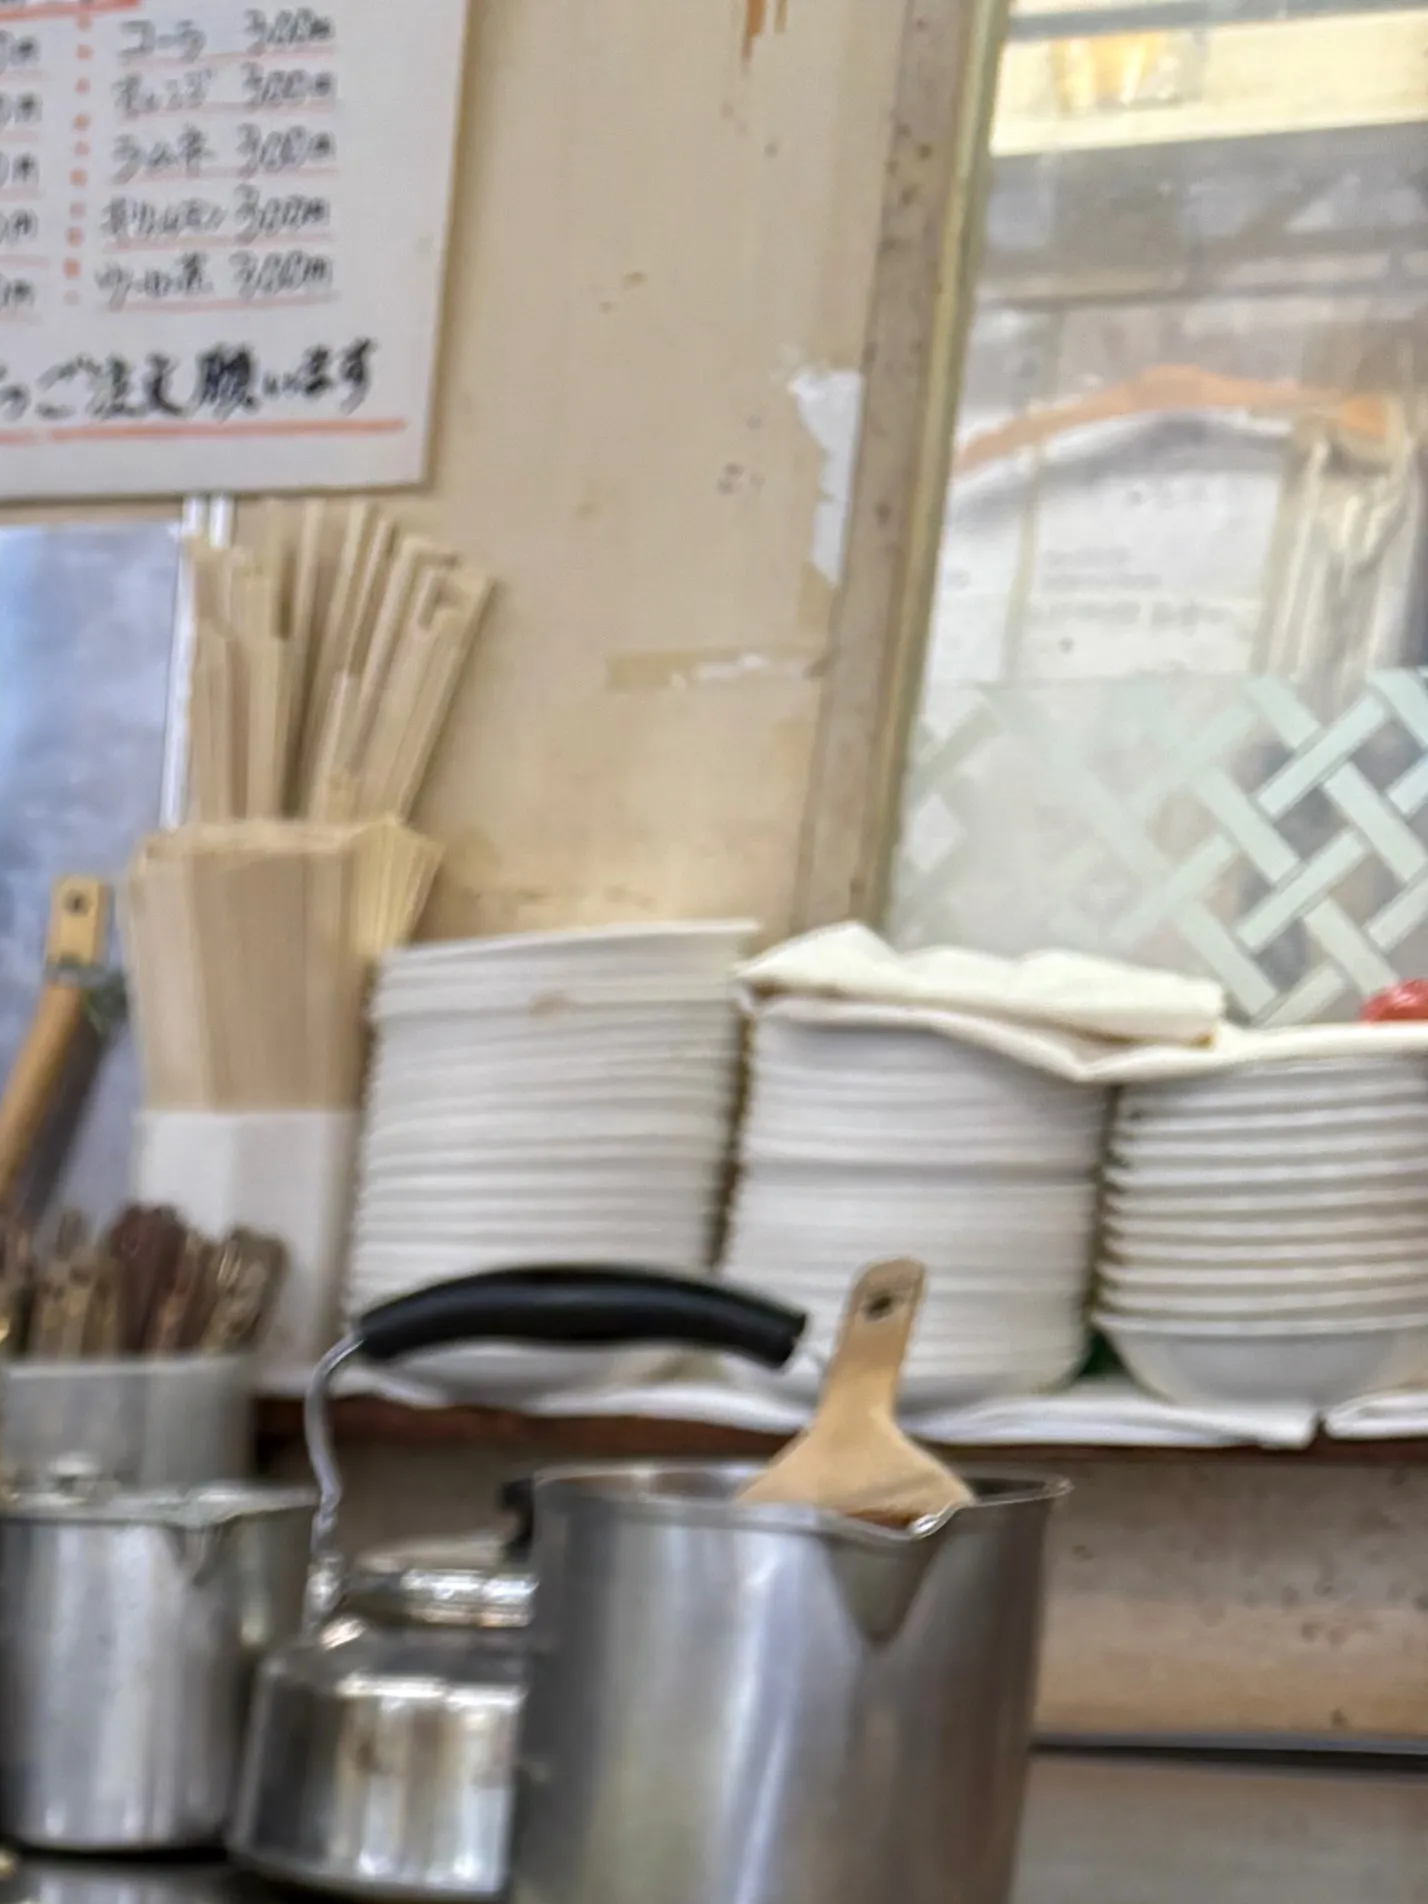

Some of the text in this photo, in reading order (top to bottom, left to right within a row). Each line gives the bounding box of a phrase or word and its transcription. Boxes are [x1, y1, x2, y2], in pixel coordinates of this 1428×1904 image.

[117, 8, 334, 62] コーラ 300円
[242, 61, 336, 110] 300円
[112, 122, 335, 184] ラムネ 300円
[234, 182, 331, 244] 300円
